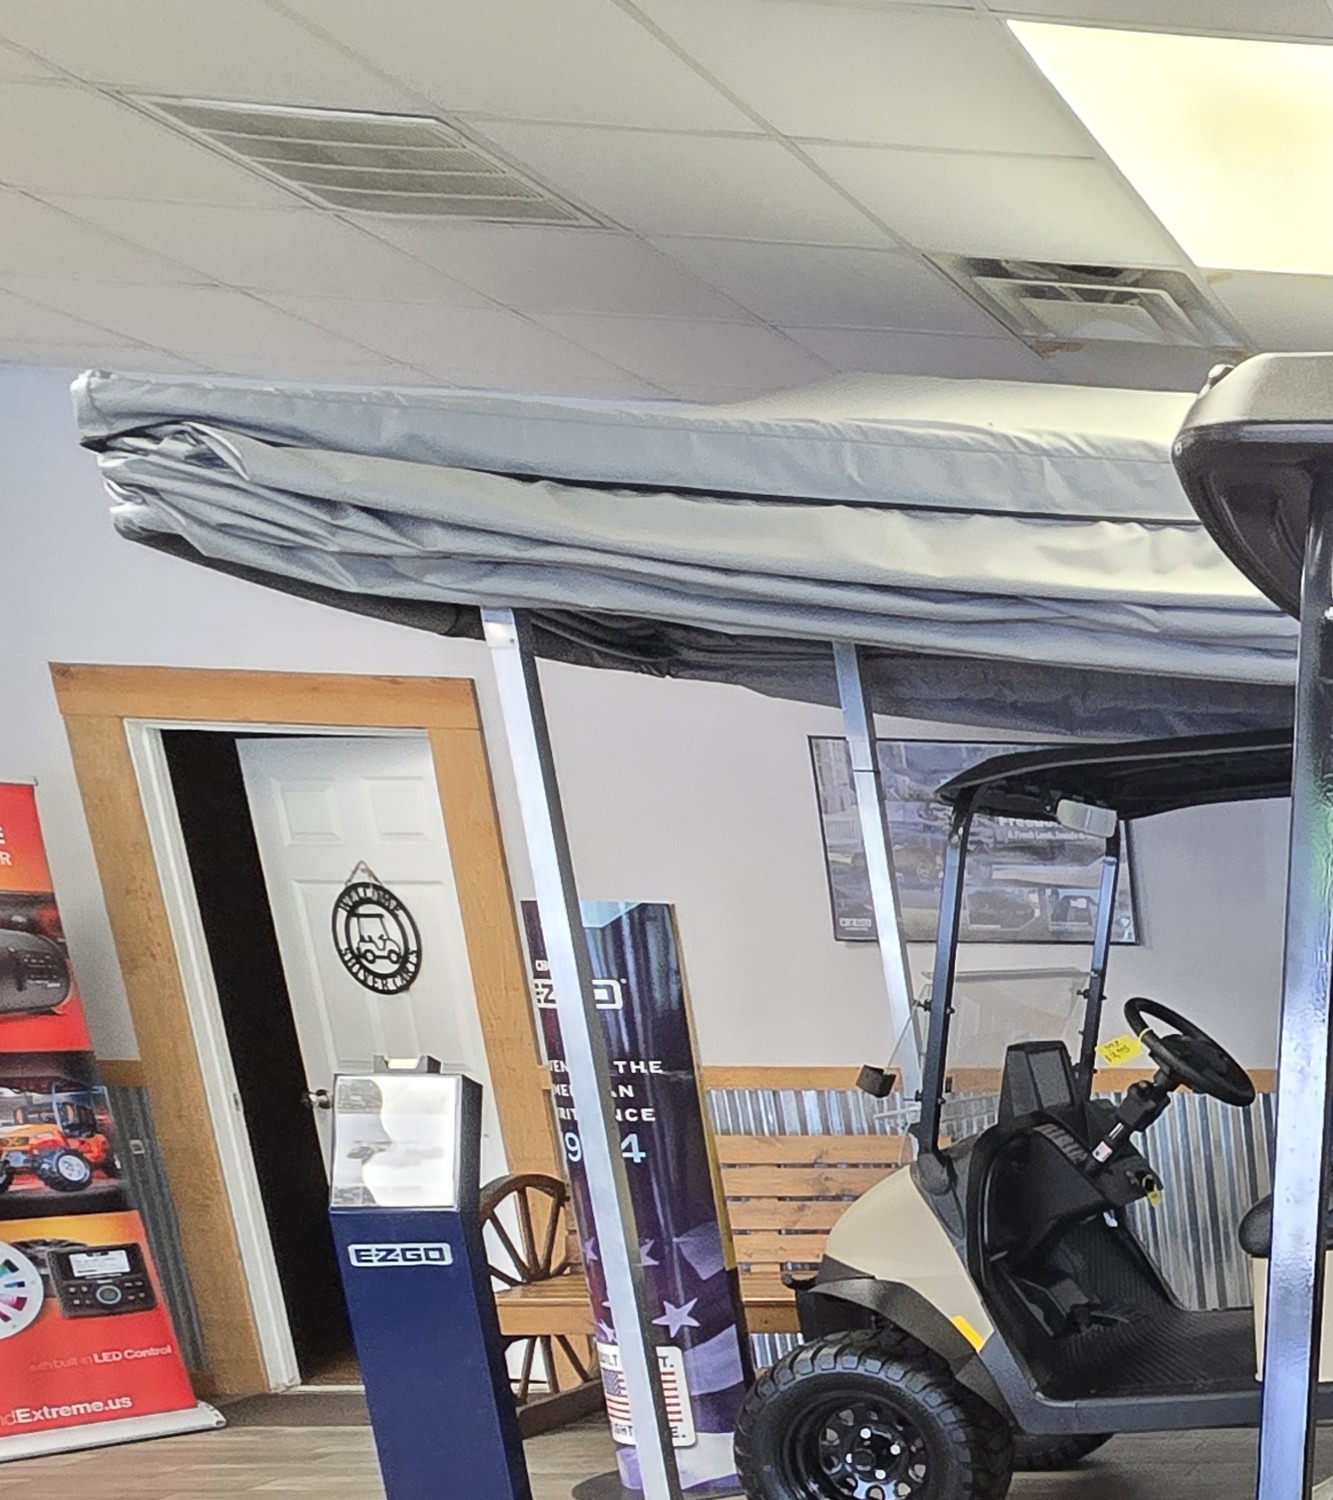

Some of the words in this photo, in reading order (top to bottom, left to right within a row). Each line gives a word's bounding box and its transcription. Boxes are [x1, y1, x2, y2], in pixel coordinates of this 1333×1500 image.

[613, 1060, 663, 1074] THE
[93, 1348, 122, 1364] LED
[124, 1344, 172, 1360] Control
[0, 1397, 133, 1427] ndExtreme.us
